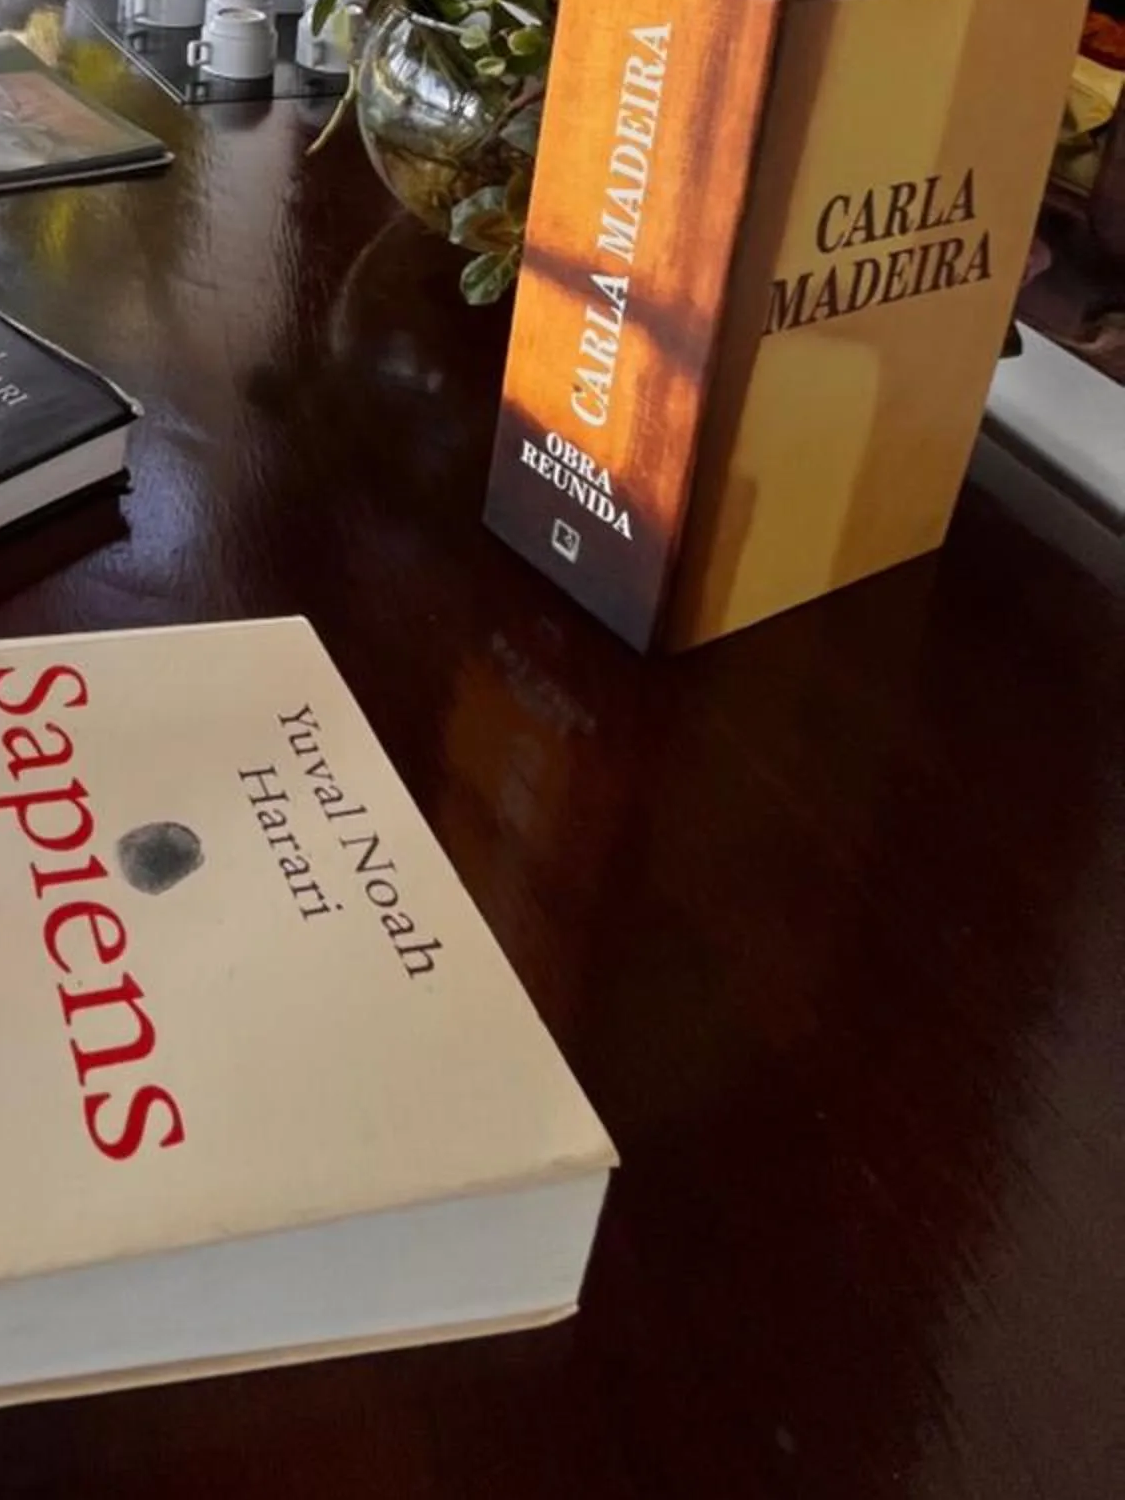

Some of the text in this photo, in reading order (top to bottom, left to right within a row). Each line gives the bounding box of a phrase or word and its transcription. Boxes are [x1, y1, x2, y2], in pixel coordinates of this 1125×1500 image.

[570, 21, 672, 427] CARLA MADEIRA
[816, 167, 976, 254] CARLA
[762, 229, 991, 336] MADEIRA
[519, 439, 633, 541] REUNIDA
[546, 432, 612, 496] OBRA
[237, 765, 345, 921] Harari
[277, 703, 443, 980] Yuval Noah
